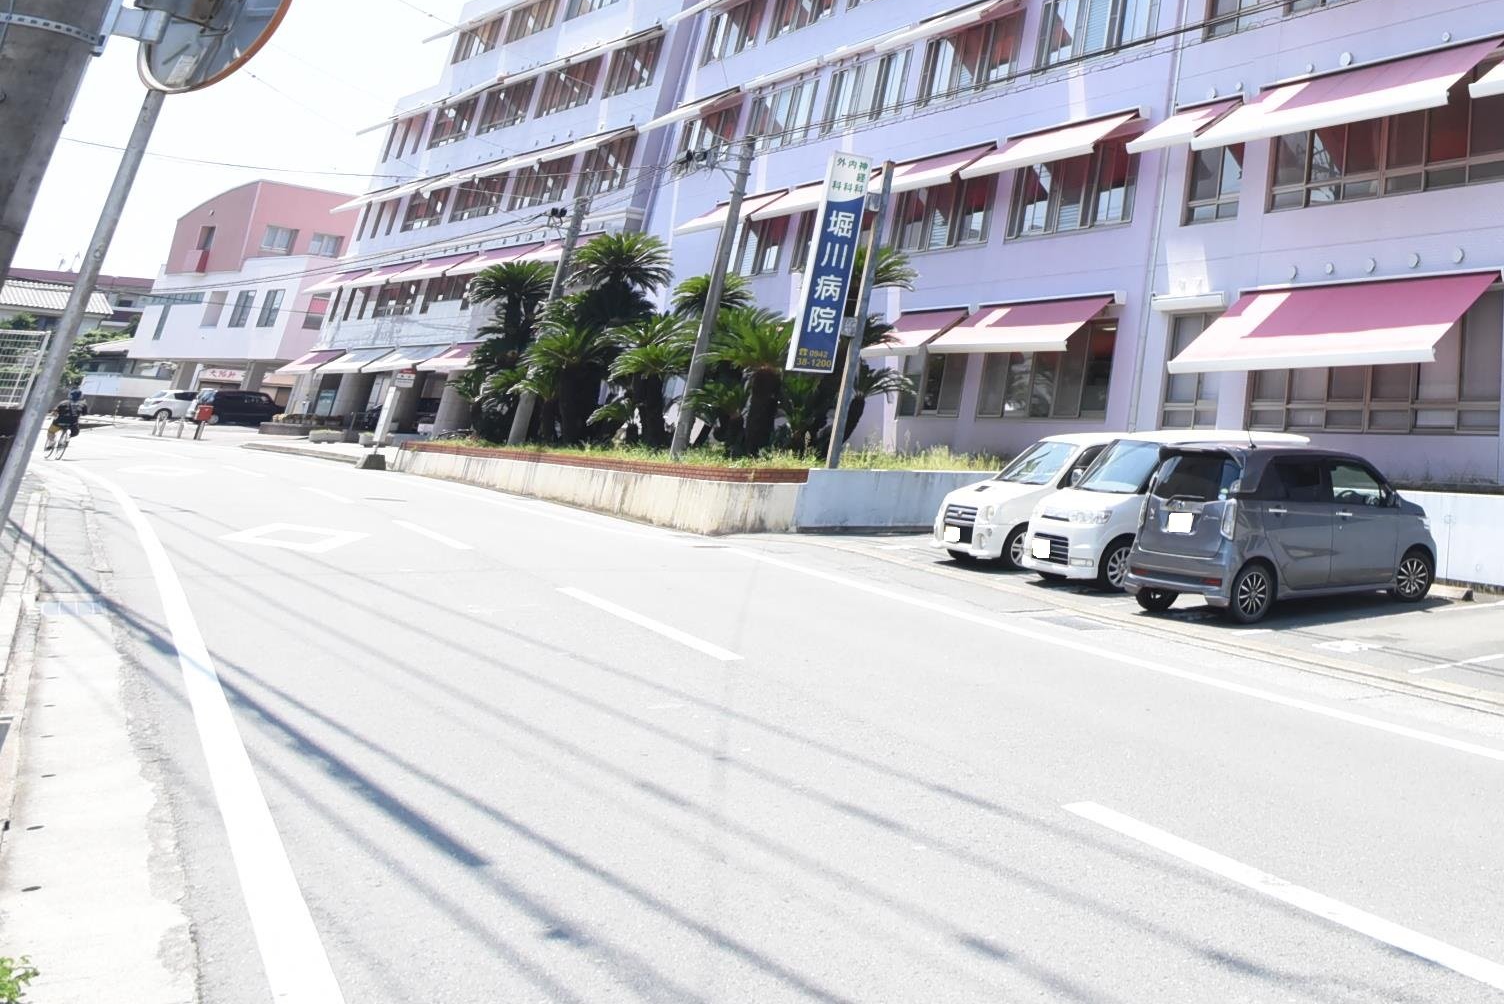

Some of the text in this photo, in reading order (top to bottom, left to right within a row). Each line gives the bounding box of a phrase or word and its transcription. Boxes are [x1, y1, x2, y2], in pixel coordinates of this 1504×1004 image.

[807, 211, 855, 334] 堀川病院
[796, 357, 832, 368] 38-1200
